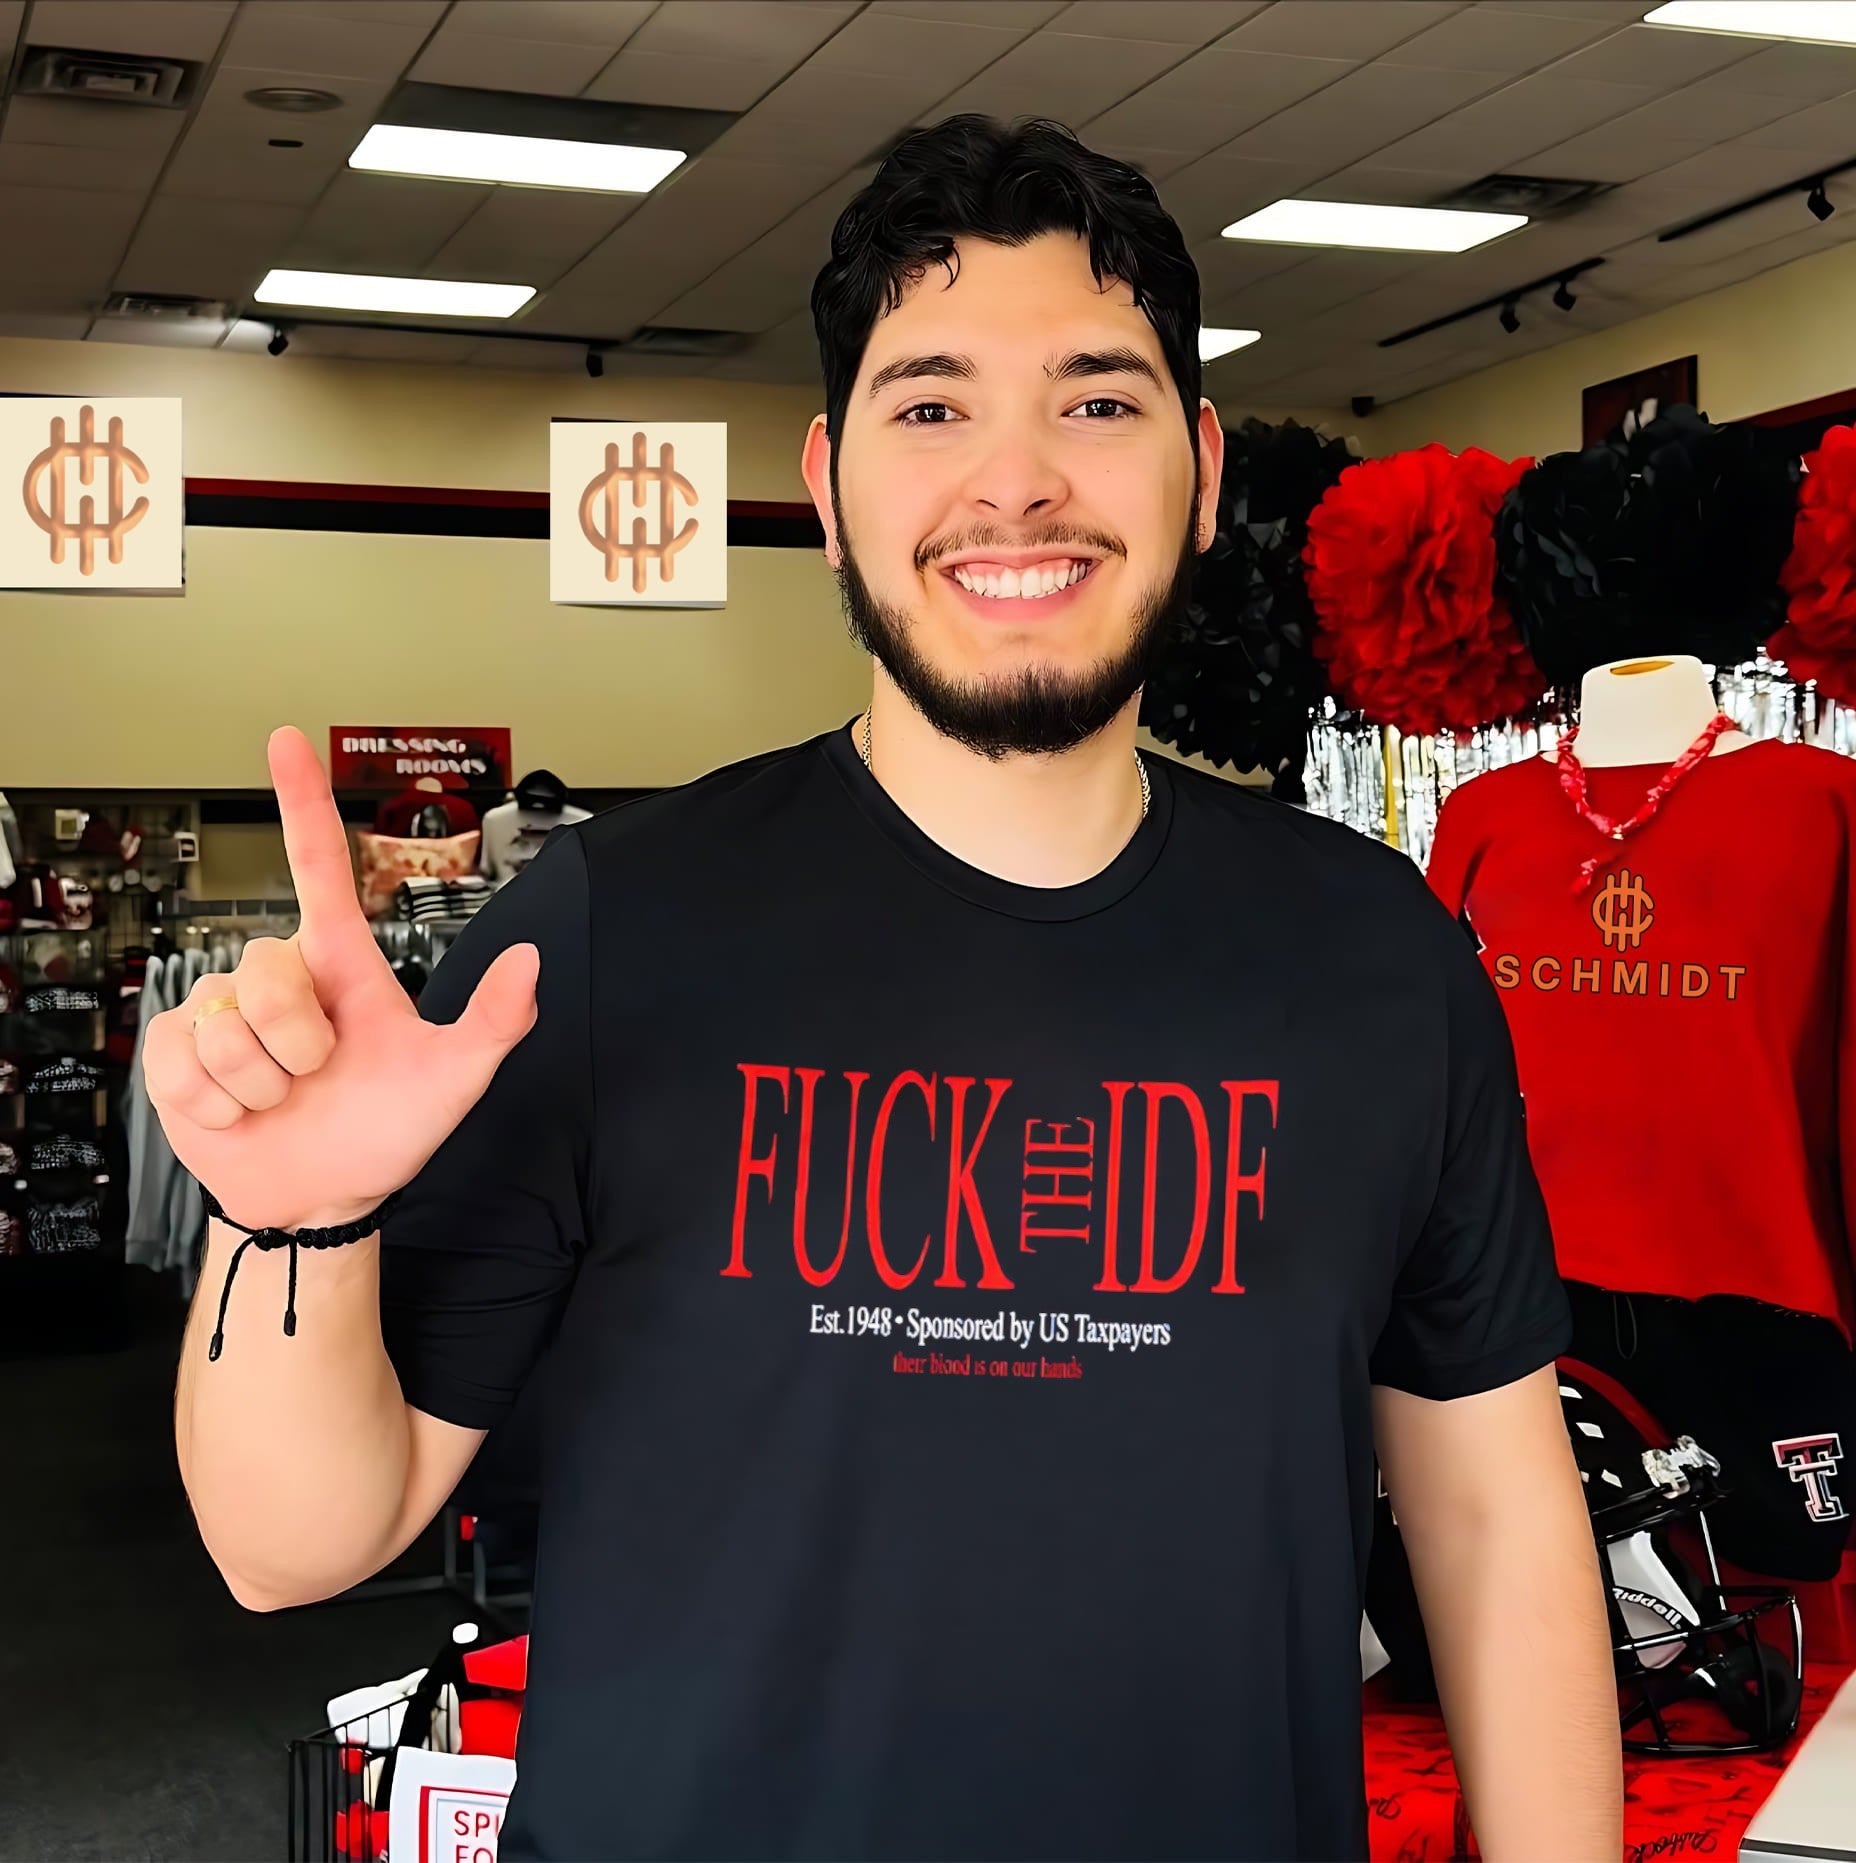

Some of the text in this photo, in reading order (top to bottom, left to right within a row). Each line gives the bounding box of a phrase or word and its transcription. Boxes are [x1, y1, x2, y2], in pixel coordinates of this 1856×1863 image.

[342, 737, 466, 753] DRESSING
[396, 759, 487, 775] ROOMS
[1494, 954, 1747, 999] SCHMIDT
[720, 1063, 1280, 1294] FUCK THE IDF
[907, 1309, 1004, 1346] Sponsored
[1010, 1312, 1034, 1349] by
[1039, 1313, 1069, 1342] US
[1075, 1314, 1171, 1351] Taxpayers
